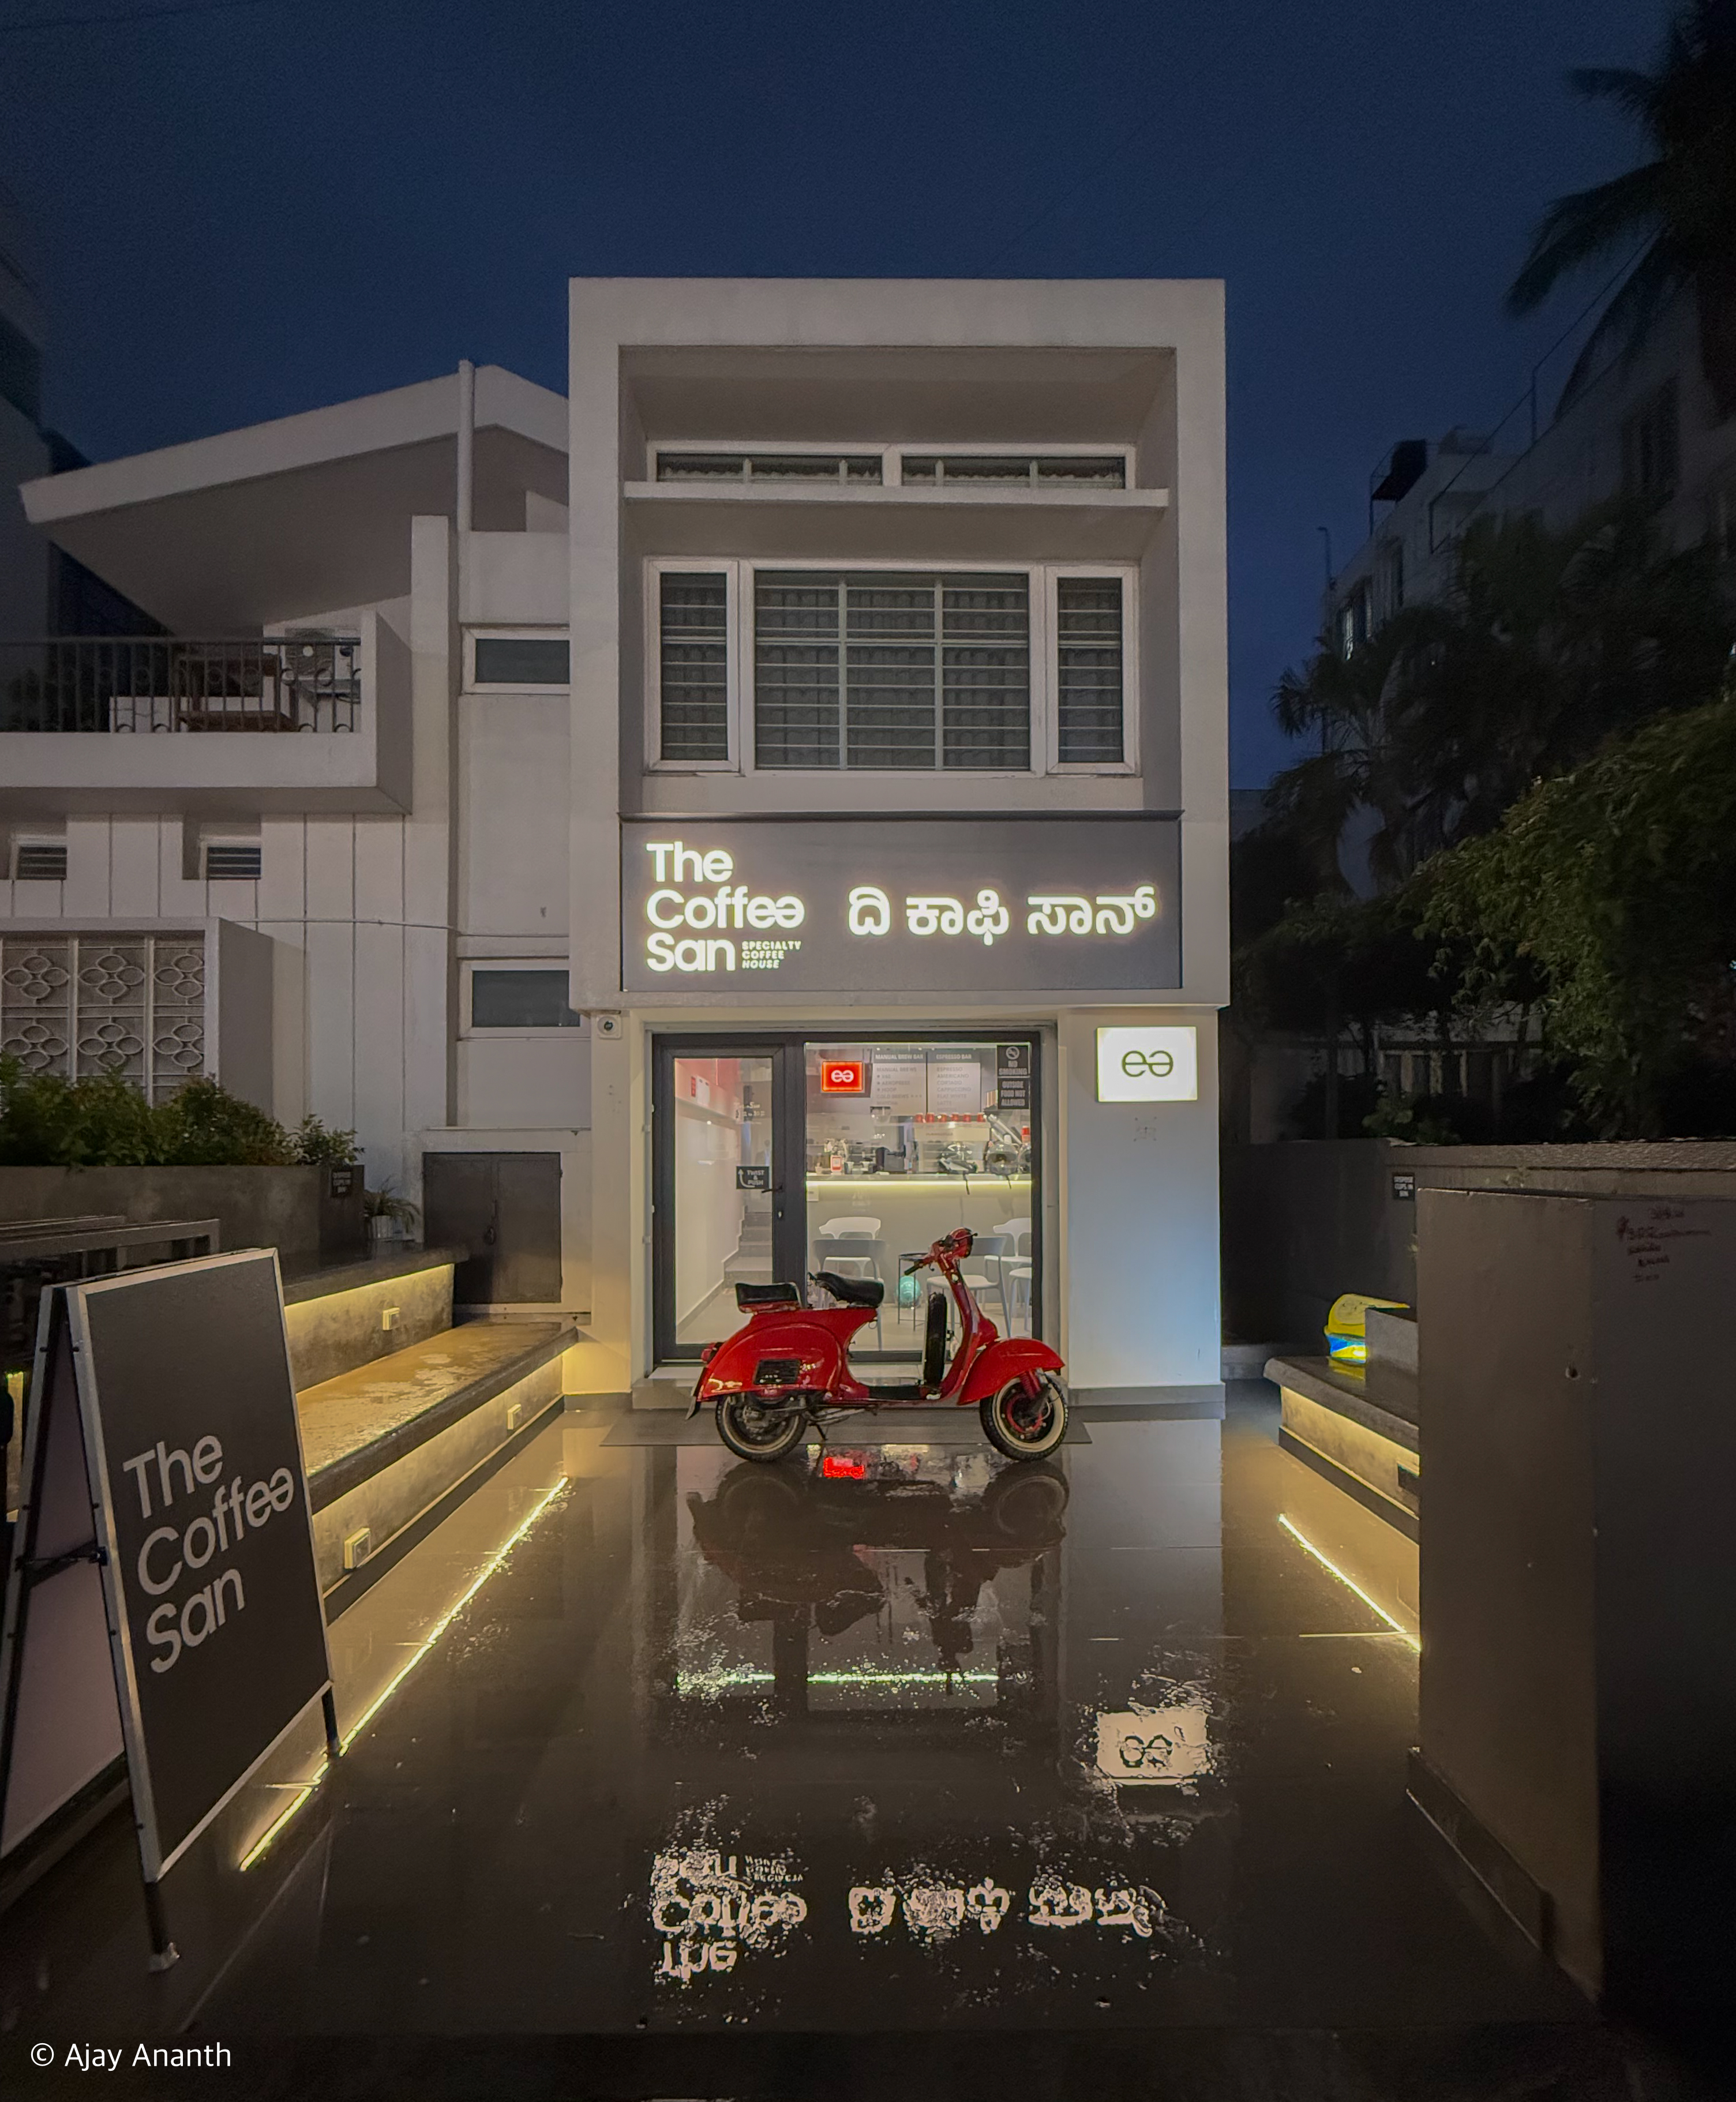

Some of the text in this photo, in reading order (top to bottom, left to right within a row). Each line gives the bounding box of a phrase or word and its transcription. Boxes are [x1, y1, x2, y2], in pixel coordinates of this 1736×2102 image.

[646, 841, 733, 883] The
[647, 885, 805, 929] Coffee
[848, 885, 1156, 946] ದಿ ಕಾಫಿ ಸಾನ್
[647, 931, 736, 971] San
[742, 941, 802, 950] SPECIALTY
[742, 950, 785, 959] COFFEE
[742, 959, 780, 969] HOUSE
[122, 1435, 224, 1519] The
[137, 1467, 294, 1596] Coffee
[145, 1568, 245, 1674] San
